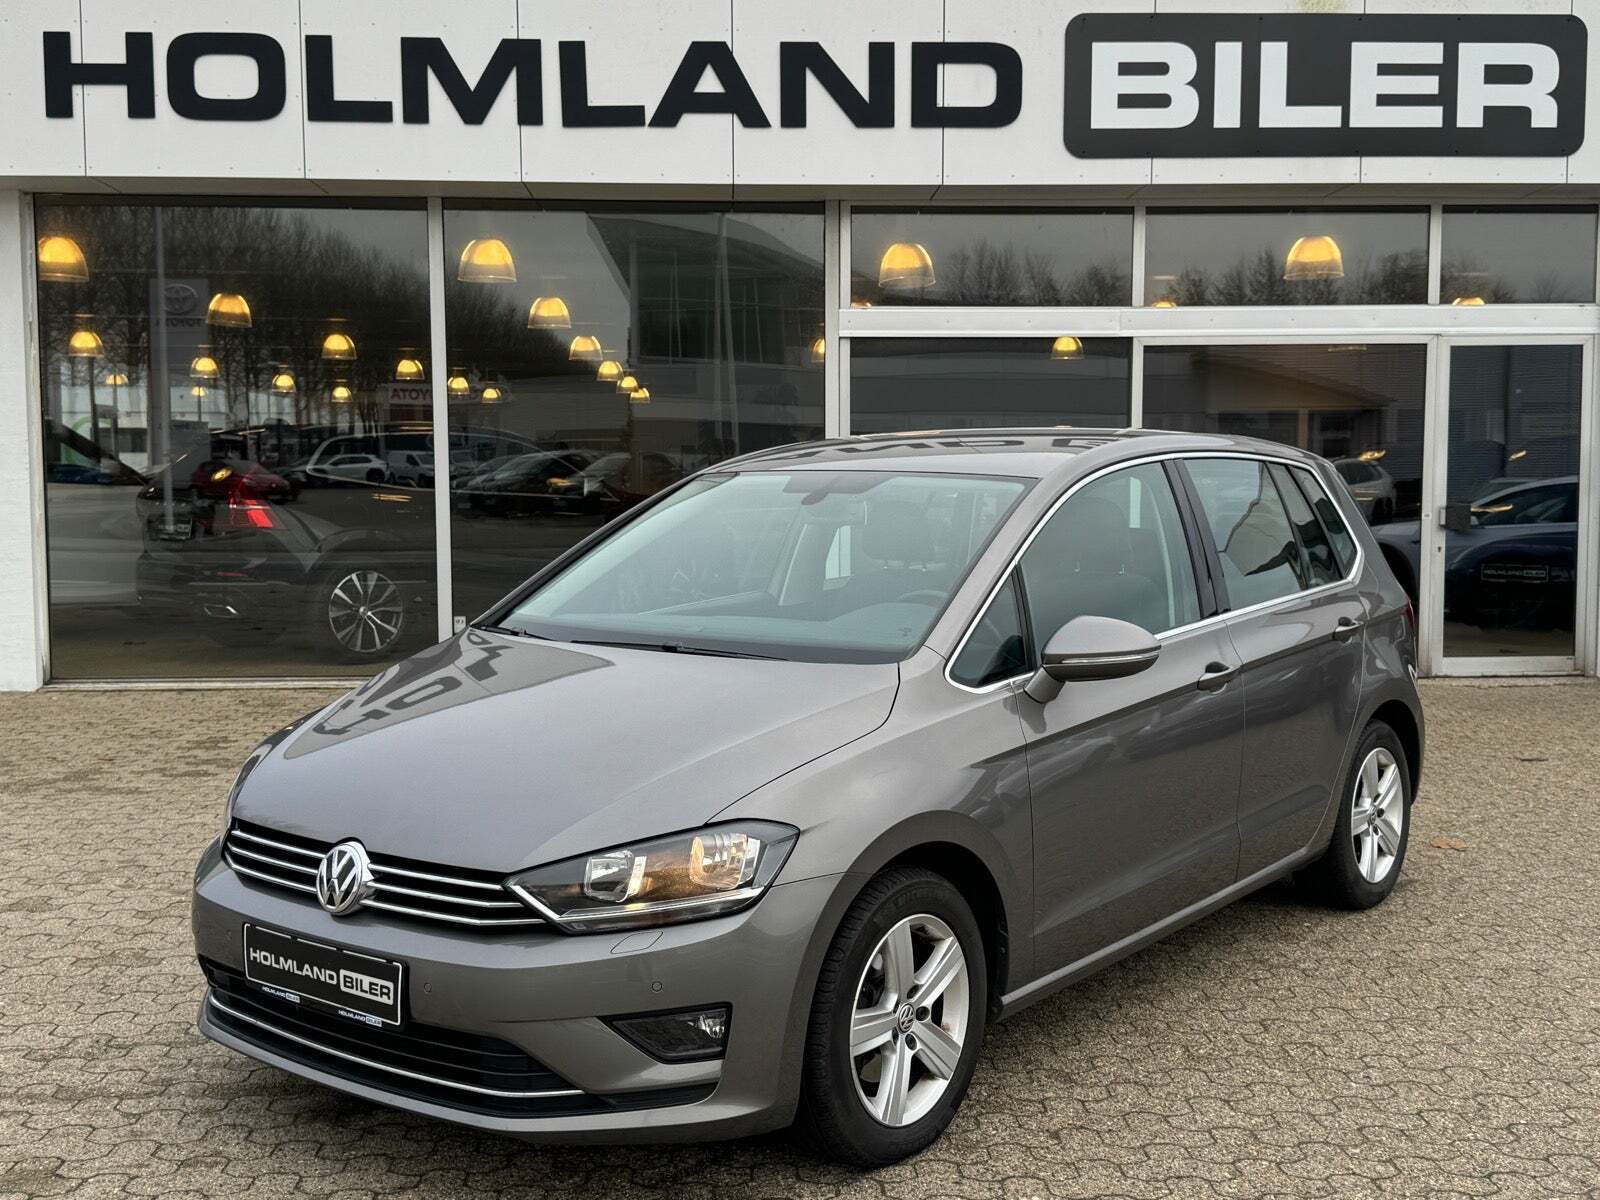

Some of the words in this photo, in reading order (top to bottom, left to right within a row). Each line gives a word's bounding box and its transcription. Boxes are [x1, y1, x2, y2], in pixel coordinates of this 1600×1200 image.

[43, 31, 1023, 128] HOLMLAND
[1090, 41, 1560, 130] BILER
[249, 947, 338, 985] HOLMLAND
[343, 971, 393, 1001] BILER
